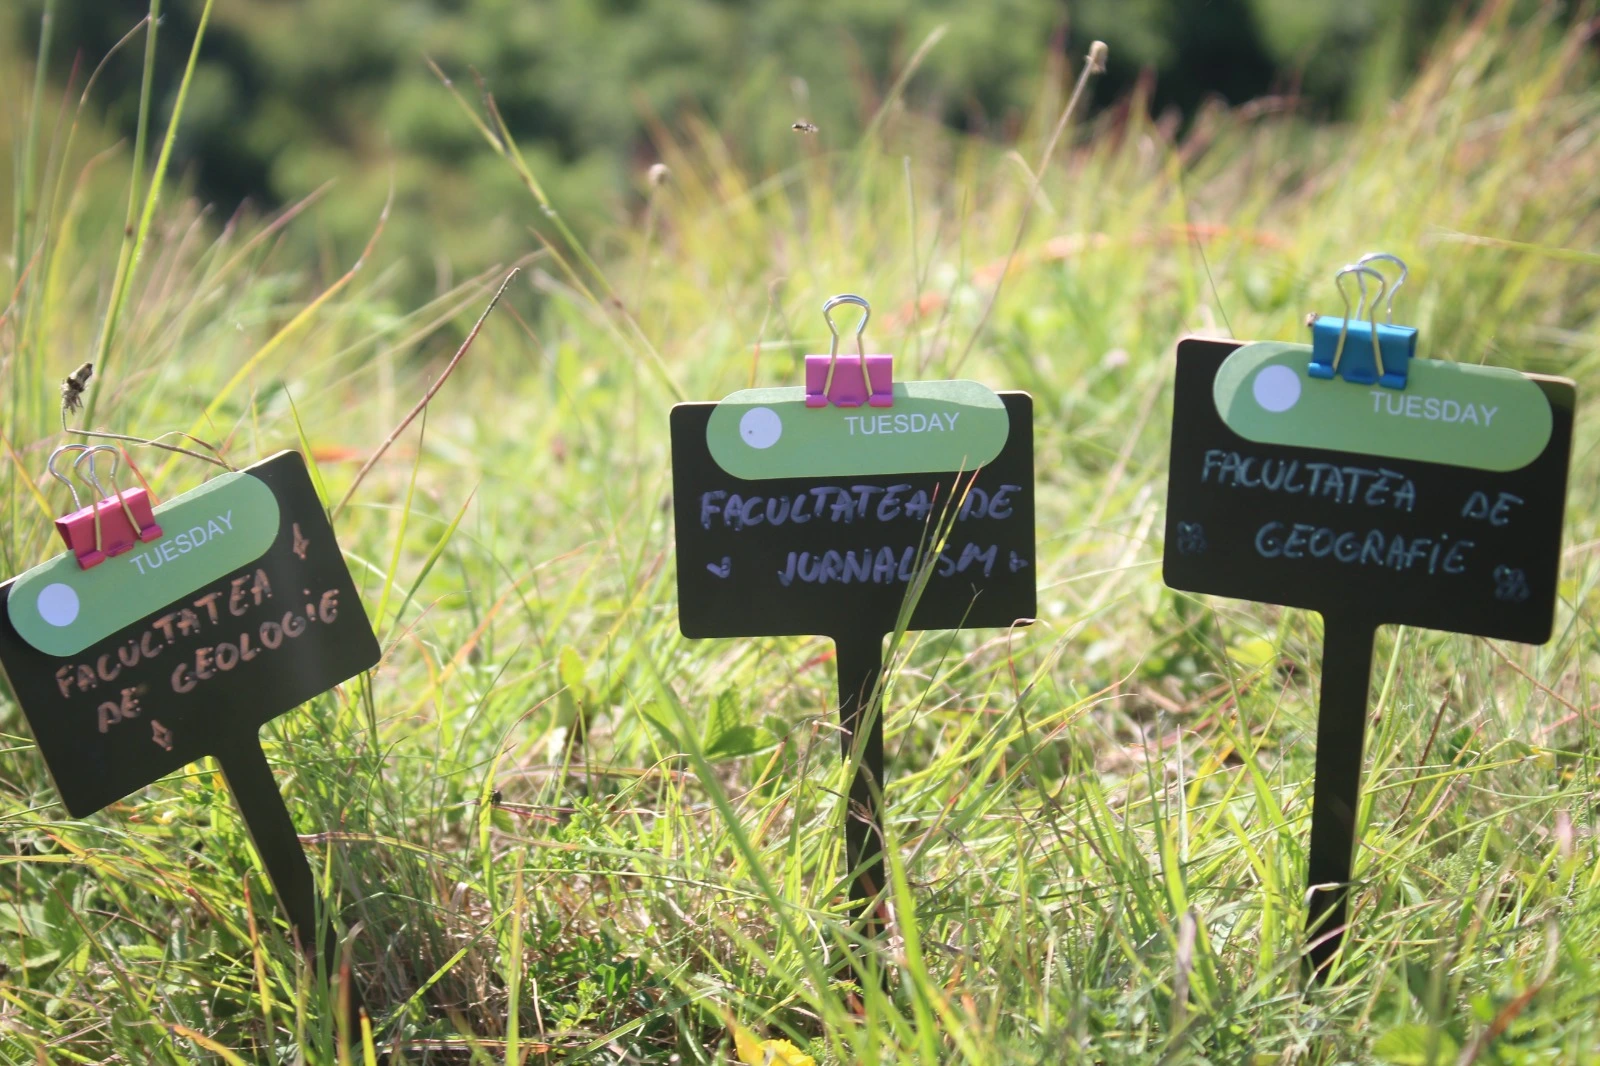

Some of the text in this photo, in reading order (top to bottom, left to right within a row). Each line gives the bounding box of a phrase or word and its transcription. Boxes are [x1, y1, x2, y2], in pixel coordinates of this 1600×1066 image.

[844, 412, 961, 436] TUESDAY
[1370, 391, 1498, 427] TUESDAY
[700, 484, 1023, 531] FACULTATEA DE
[1201, 449, 1524, 526] FACULTATEA DE
[129, 510, 234, 575] TUESDAY
[777, 542, 999, 587] JURNALSM
[55, 568, 273, 698] FACULTATEA
[97, 686, 142, 734] DE
